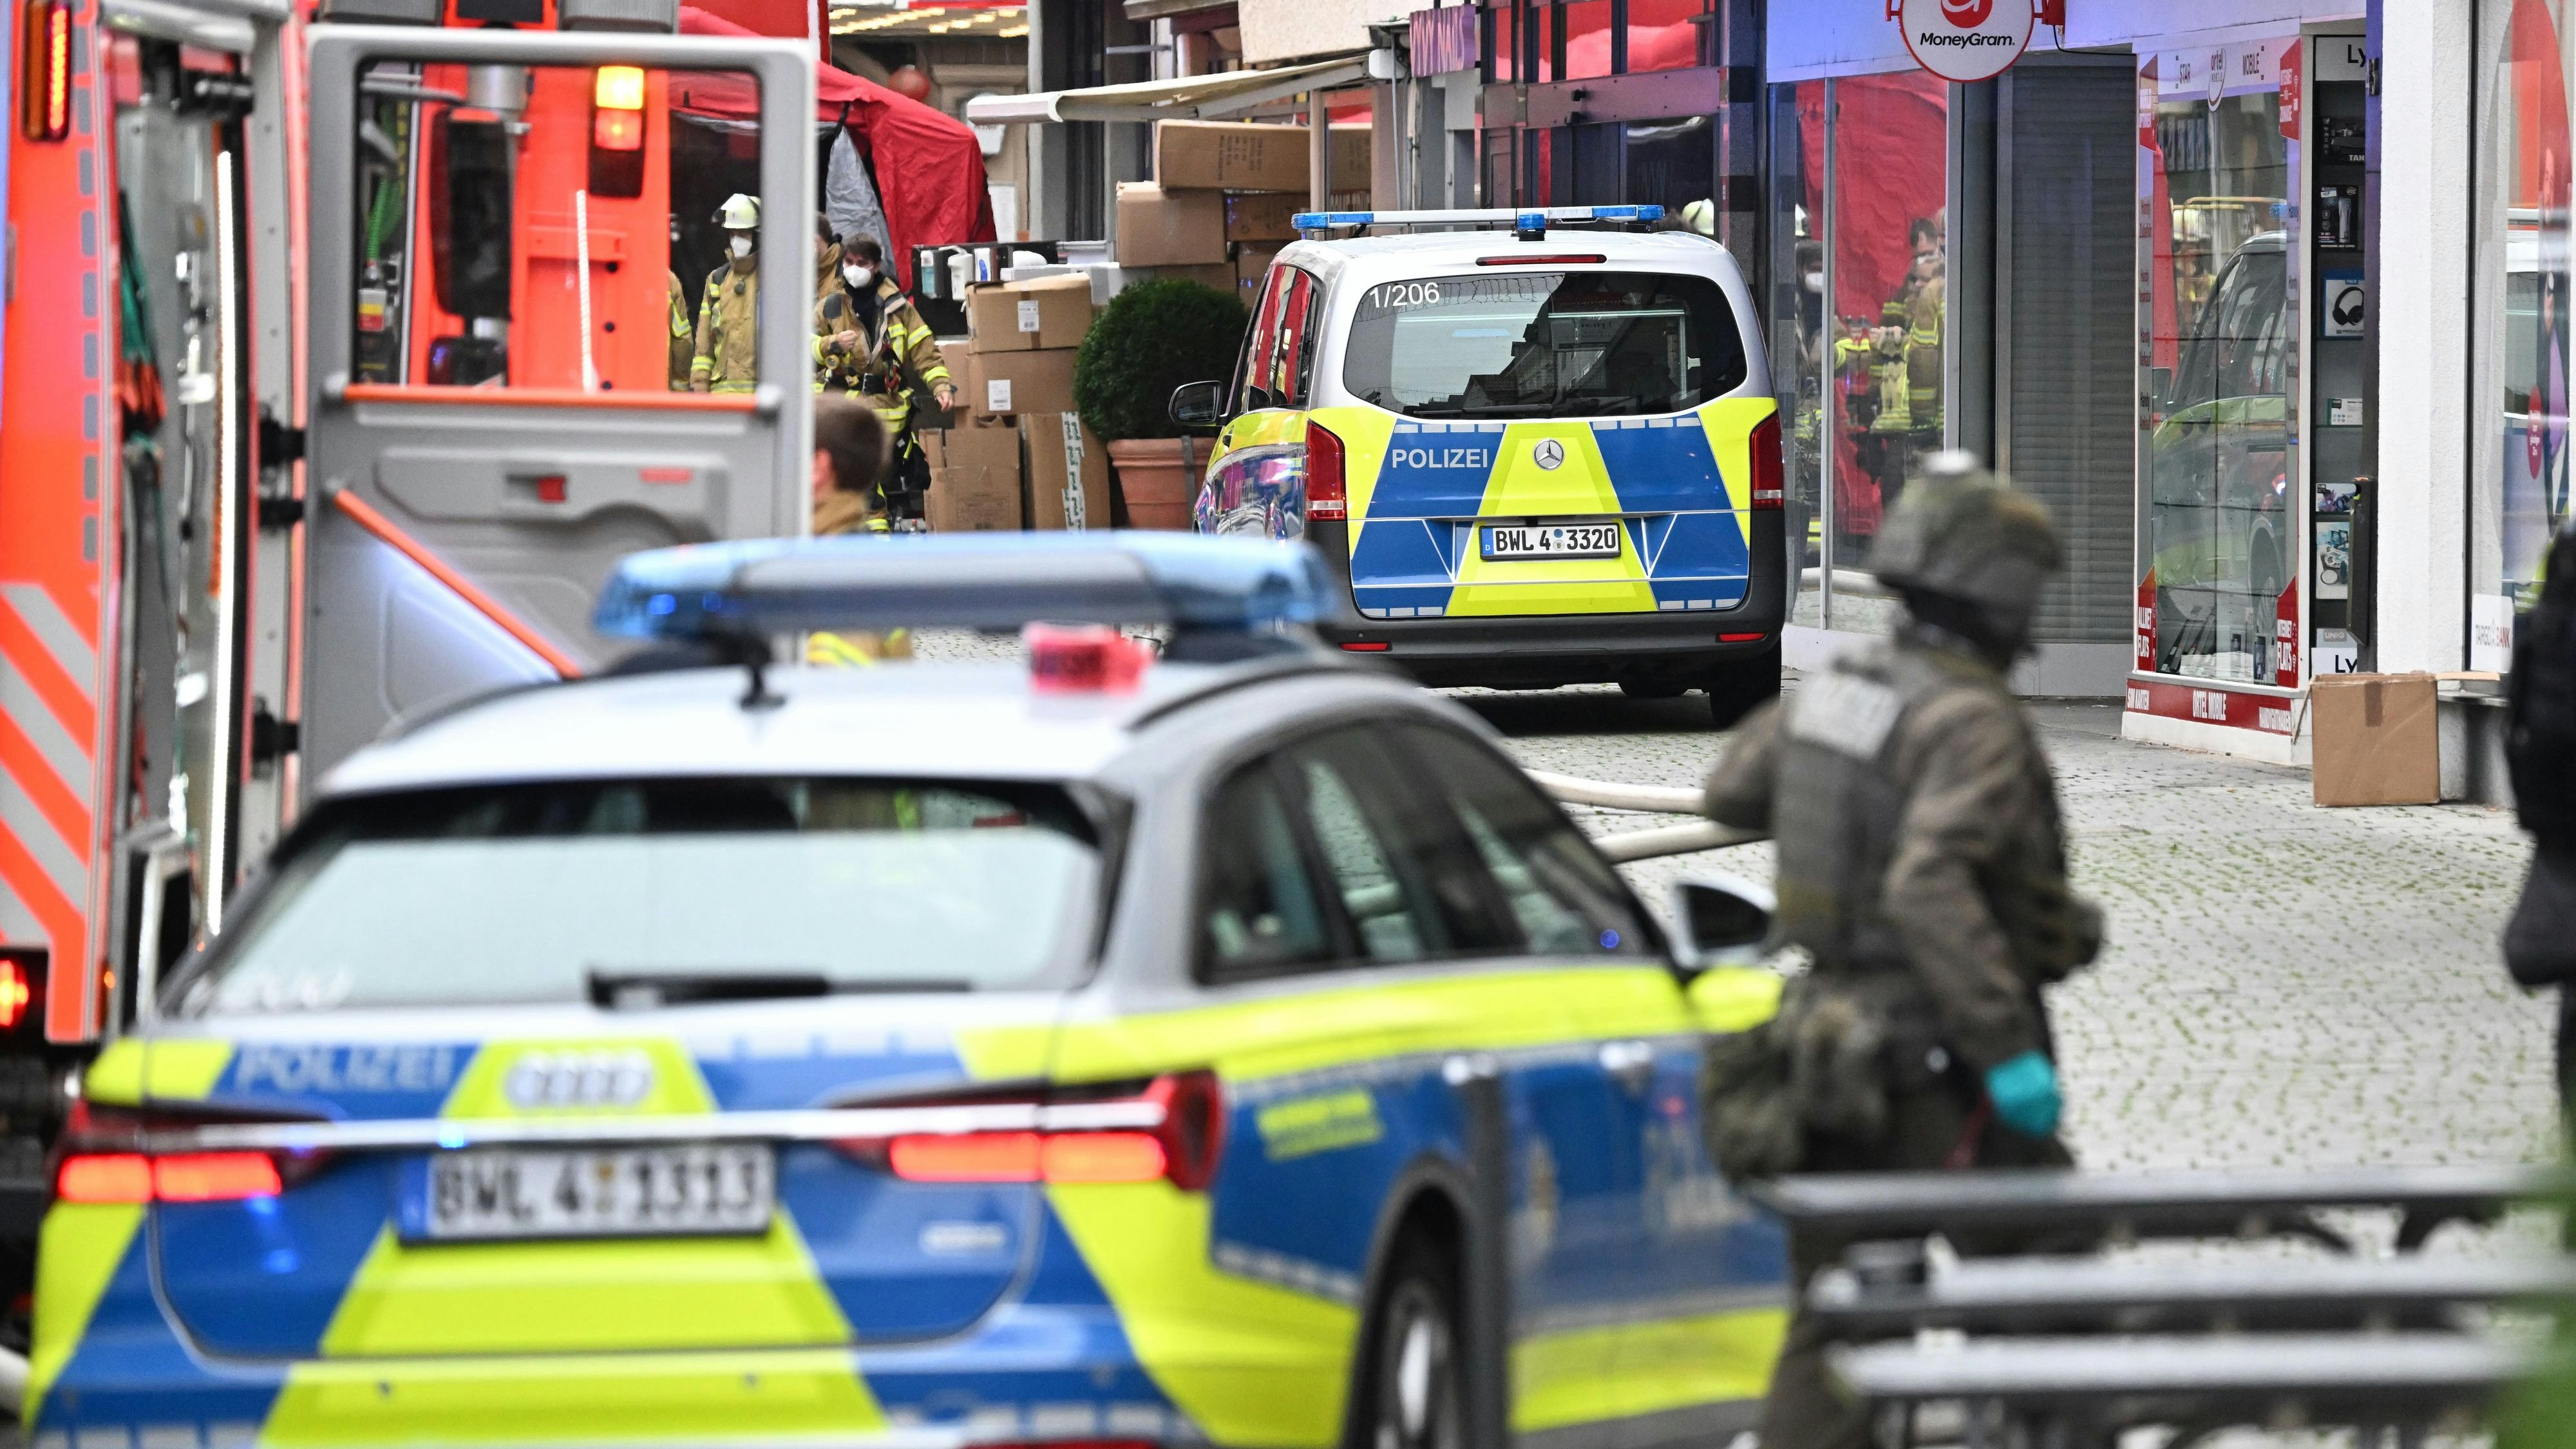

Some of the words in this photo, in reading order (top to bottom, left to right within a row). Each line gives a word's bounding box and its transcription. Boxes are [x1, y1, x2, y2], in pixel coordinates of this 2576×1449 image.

[1437, 5, 1464, 73] NAILS
[1920, 32, 2013, 50] MoneyGram
[2211, 49, 2224, 71] ortel
[2243, 52, 2260, 76] MOBILE
[2179, 63, 2191, 84] STAR
[1369, 281, 1440, 308] 1/206
[1392, 448, 1488, 469] POLIZEI
[1495, 529, 1534, 552] BWL
[1539, 529, 1551, 551] 4
[1566, 527, 1616, 551] 3320
[2277, 641, 2292, 672] FLATS
[2334, 654, 2358, 674] Ly
[2192, 690, 2208, 718] ORTEL
[2208, 692, 2226, 721] MOBILE
[234, 1041, 455, 1094] POLIZEI
[431, 1160, 538, 1224] BWL
[552, 1157, 584, 1216] 4
